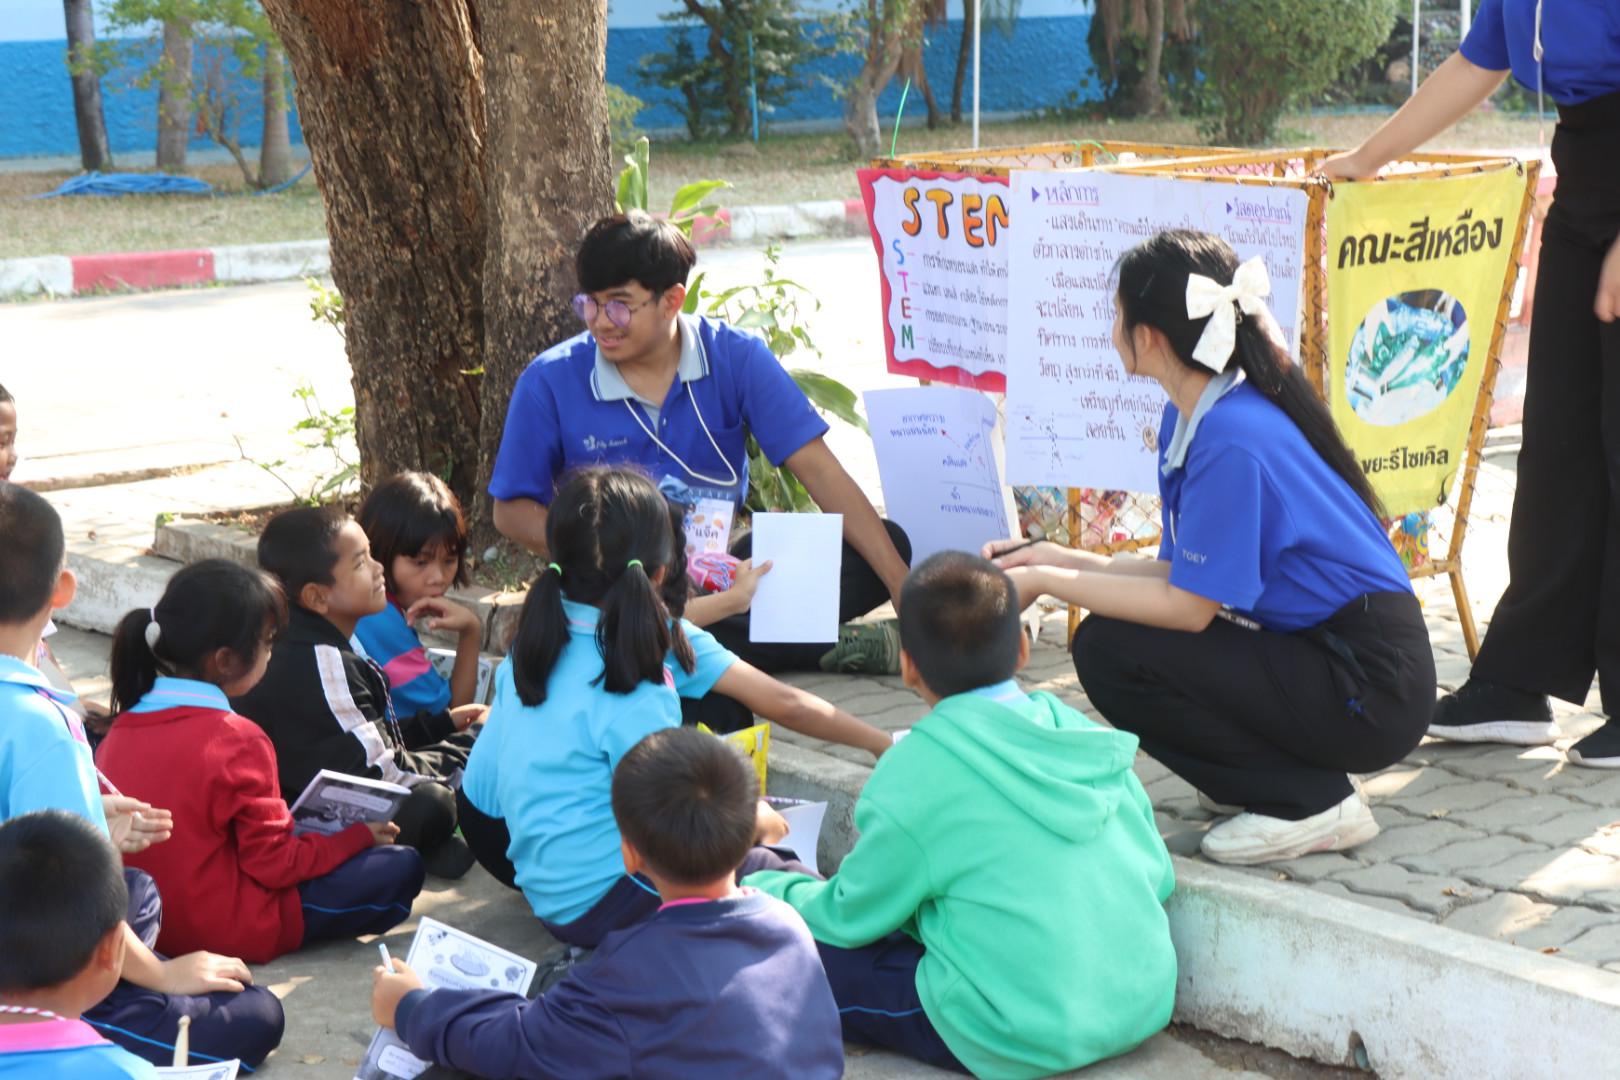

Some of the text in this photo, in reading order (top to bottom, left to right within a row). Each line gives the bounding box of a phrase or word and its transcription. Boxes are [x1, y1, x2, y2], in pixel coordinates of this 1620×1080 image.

[1337, 208, 1503, 269] คณะสีเหลือง
[893, 239, 904, 265] S
[897, 272, 908, 292] T
[901, 297, 912, 319] E
[902, 324, 914, 350] M
[1361, 446, 1449, 474] ขยะรีไซเคิล
[1182, 548, 1207, 565] TOEY
